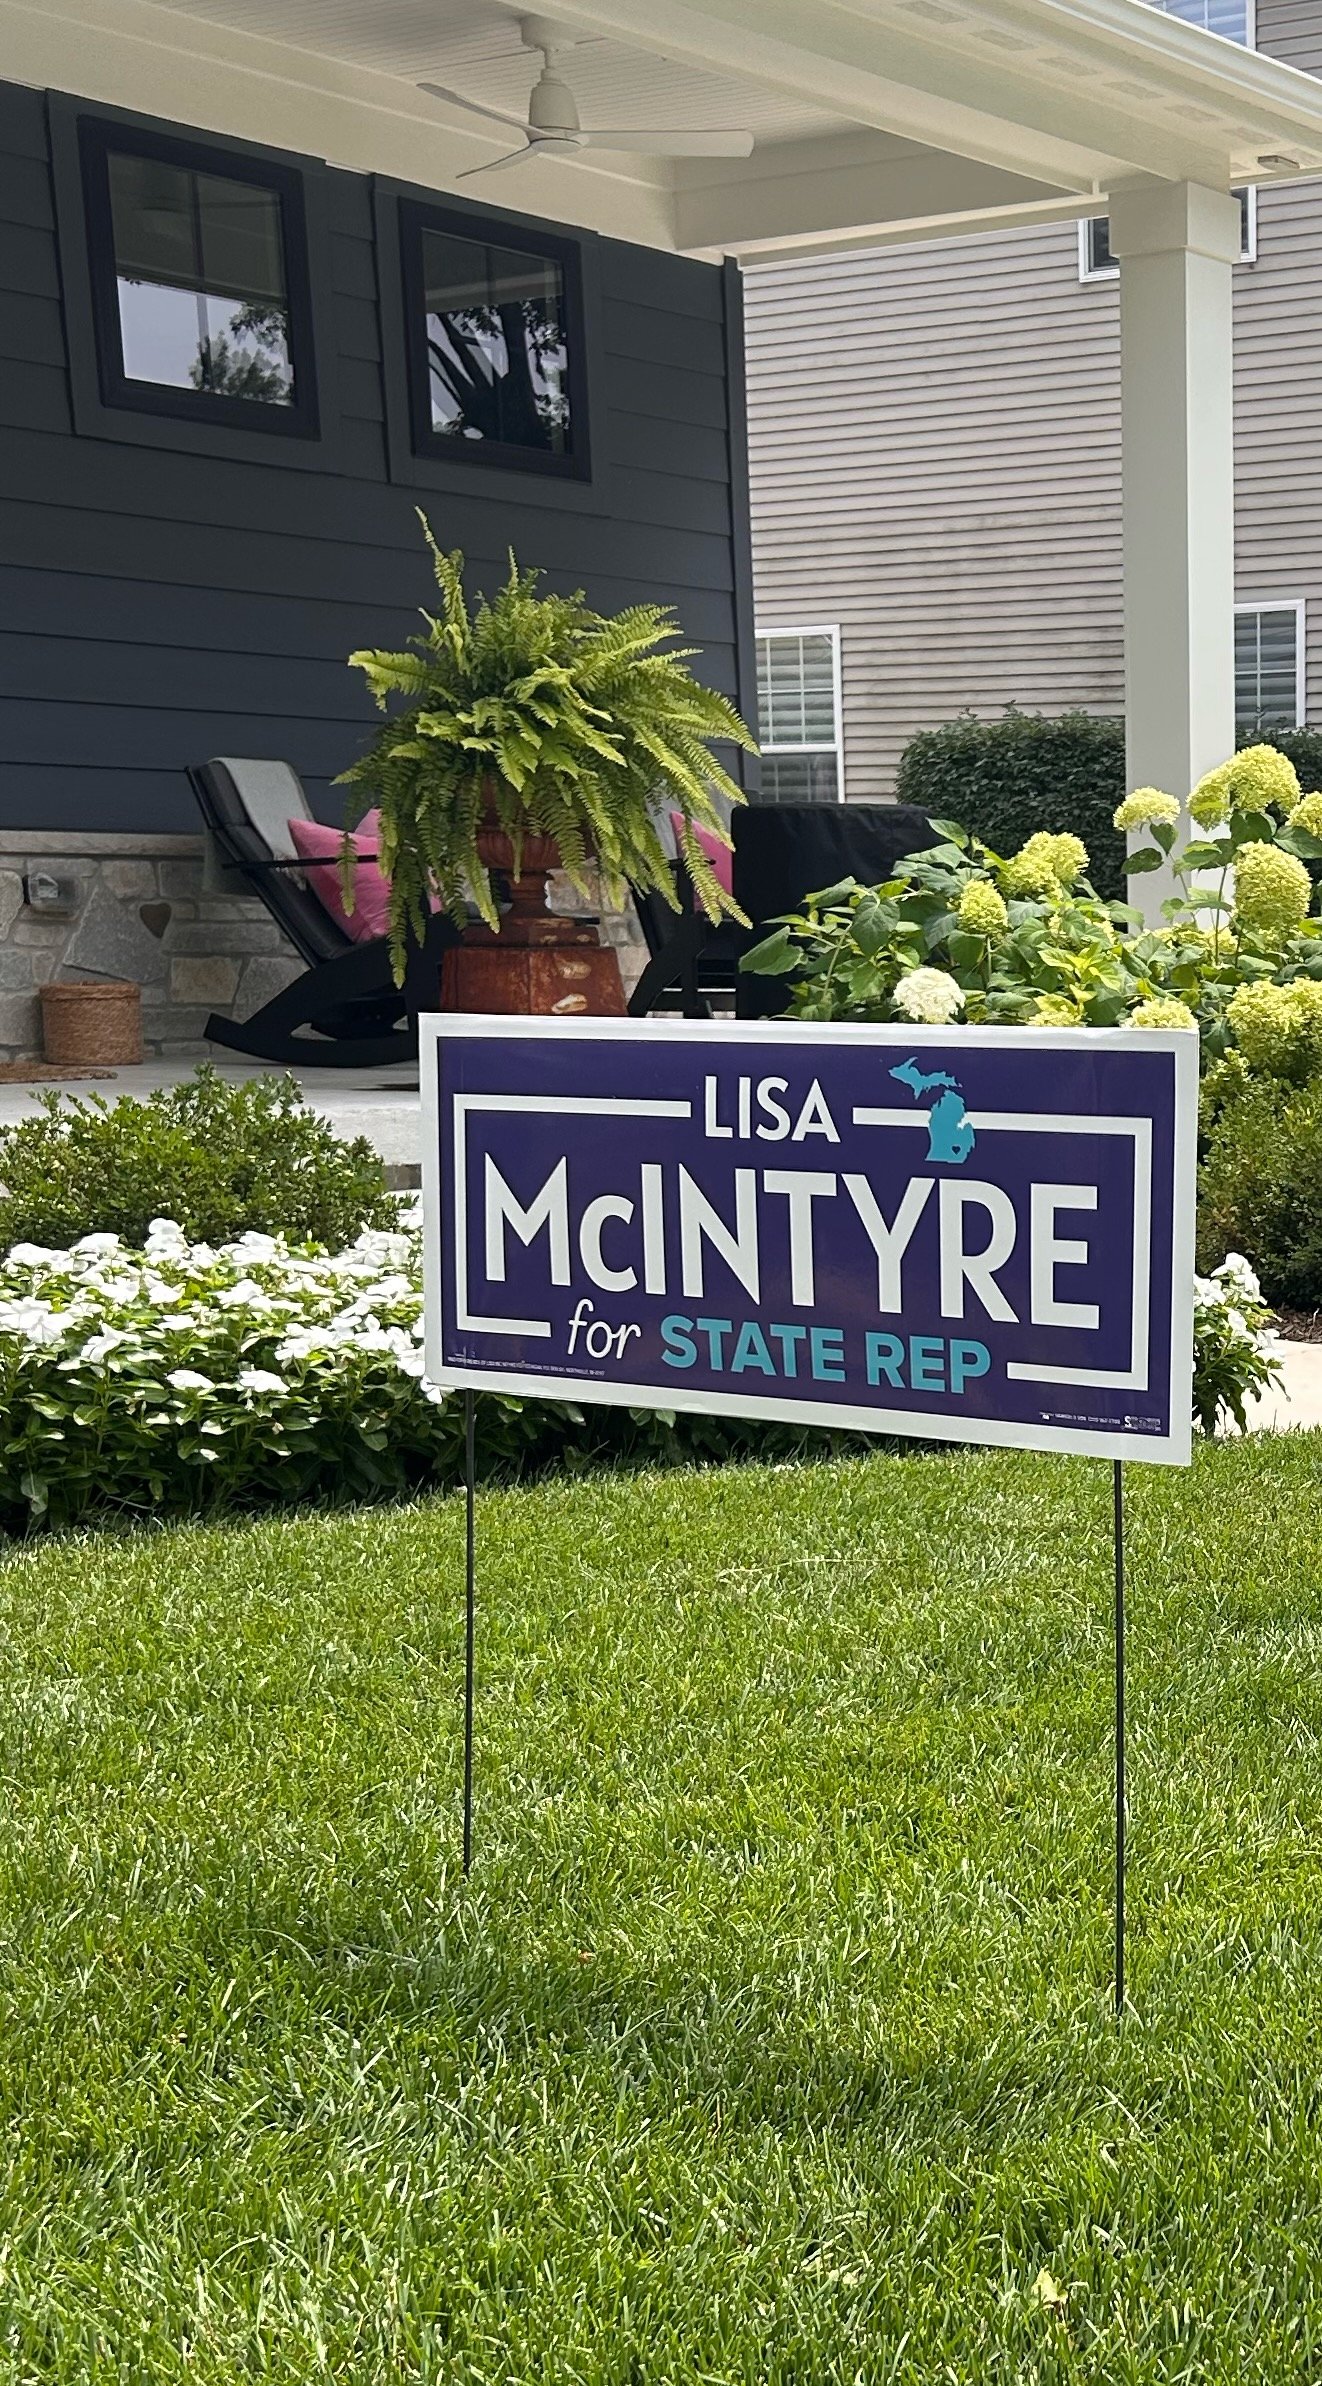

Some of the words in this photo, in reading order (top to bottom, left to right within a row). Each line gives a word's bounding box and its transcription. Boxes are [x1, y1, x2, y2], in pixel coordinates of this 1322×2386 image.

[705, 1075, 841, 1143] LISA
[484, 1152, 1101, 1330] McINTYRE
[567, 1298, 642, 1360] for
[661, 1315, 846, 1382] STATE
[865, 1331, 992, 1394] REP
